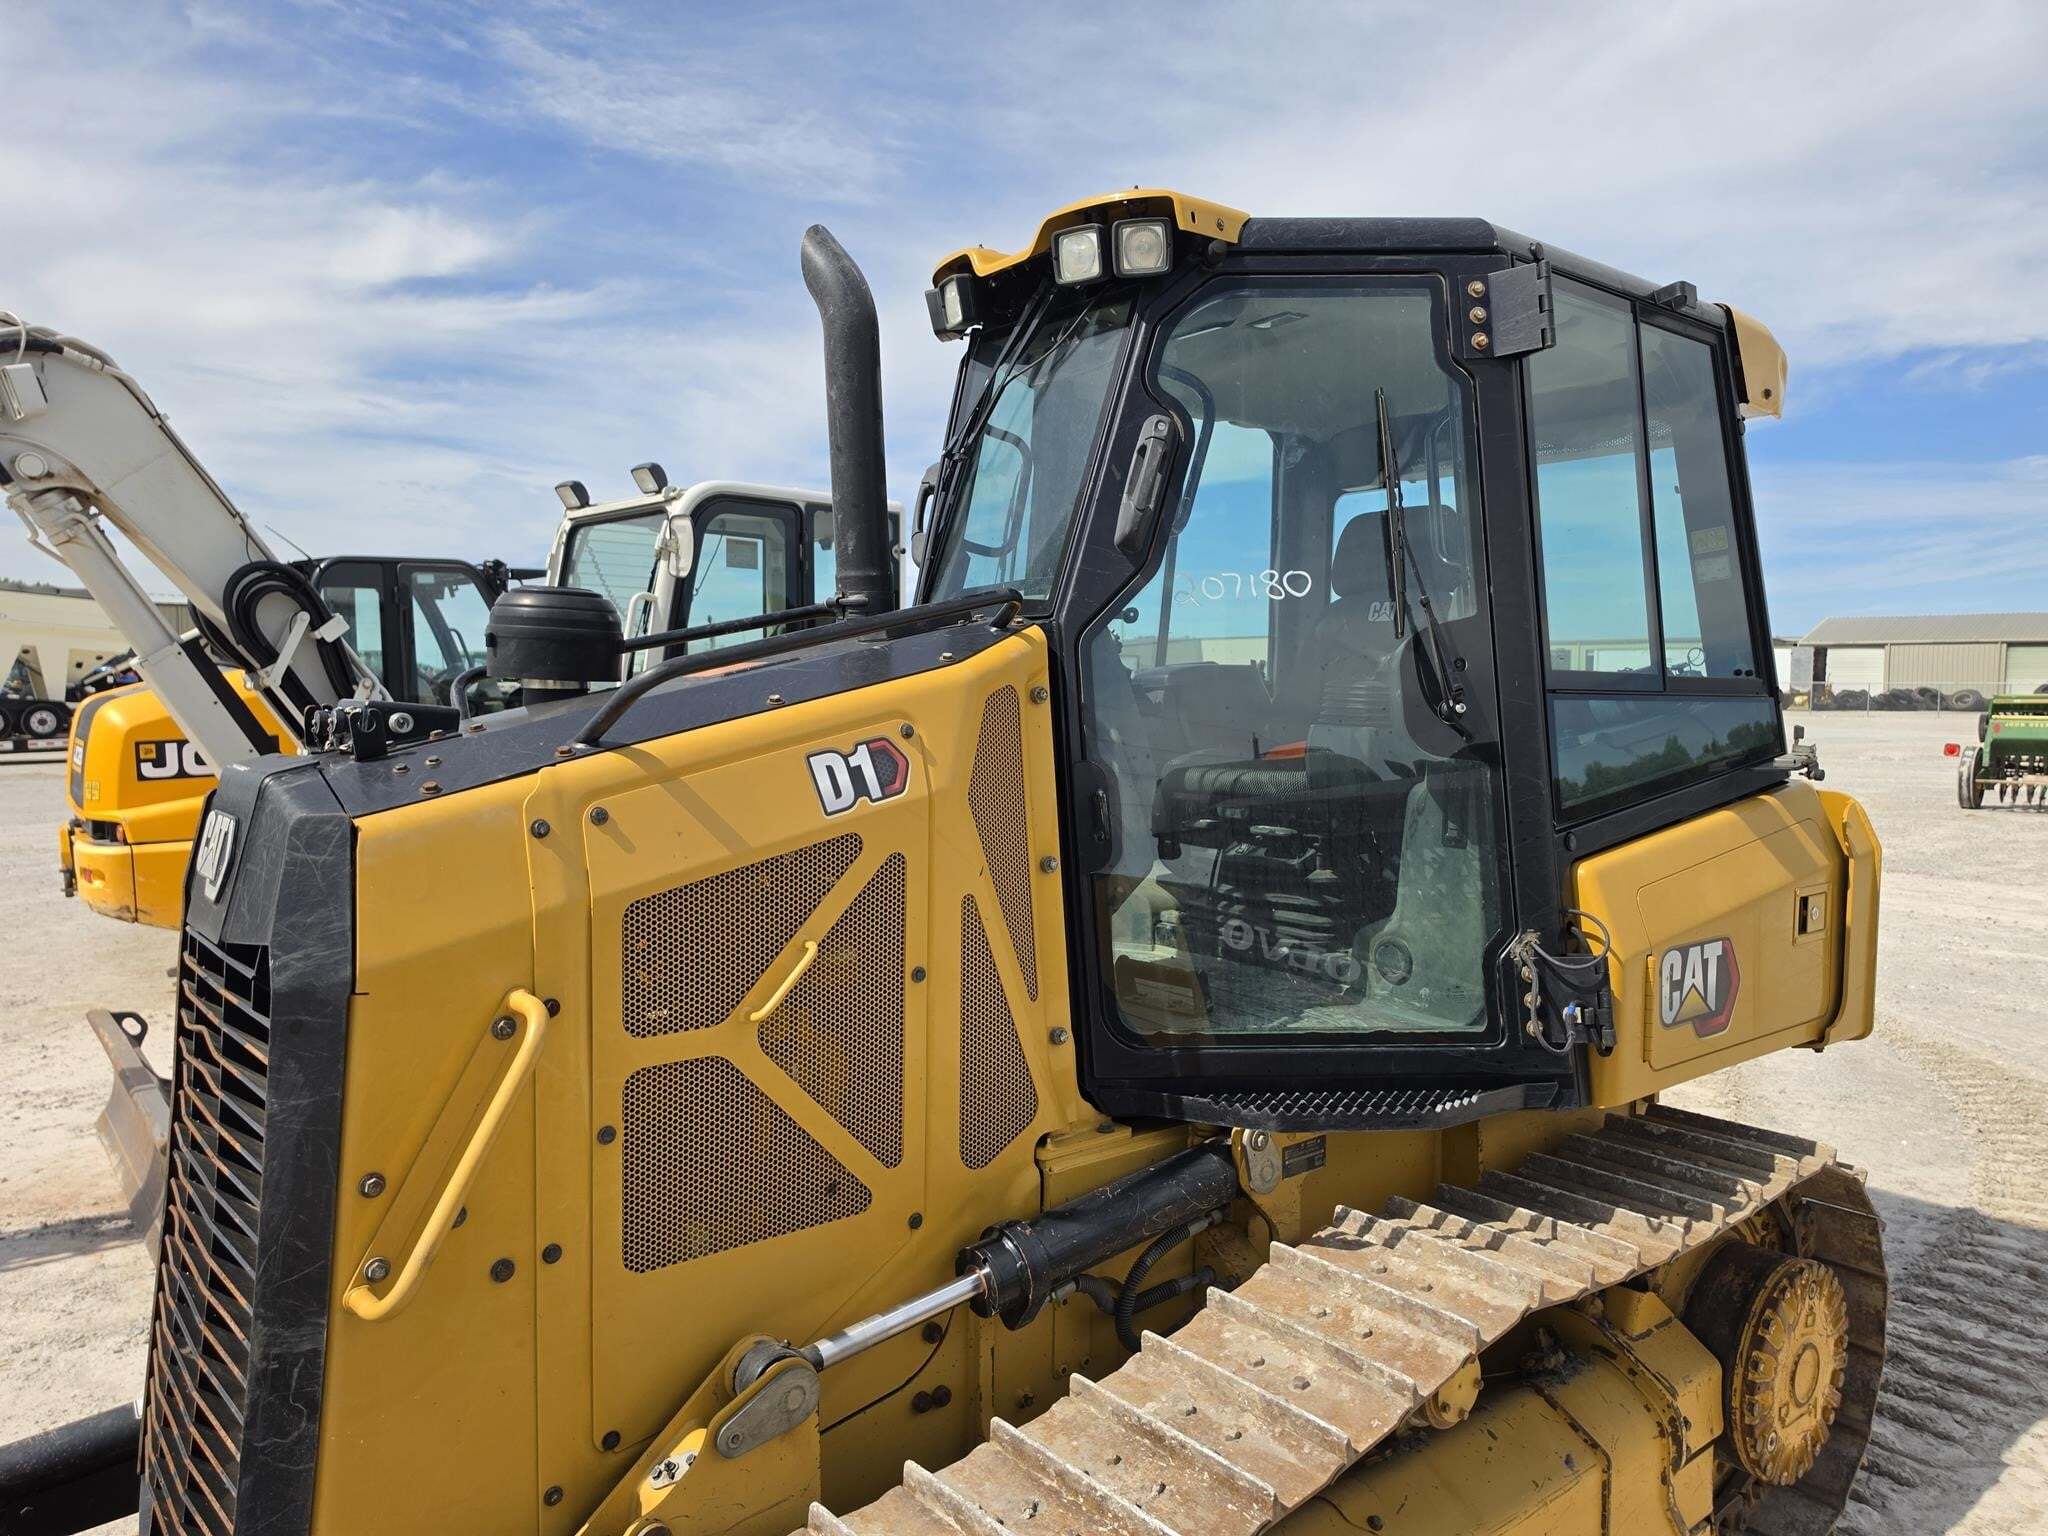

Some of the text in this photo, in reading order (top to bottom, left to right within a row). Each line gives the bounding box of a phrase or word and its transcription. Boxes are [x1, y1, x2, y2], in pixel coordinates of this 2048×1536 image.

[1173, 569, 1312, 608] 207180
[1368, 601, 1398, 622] CA
[141, 742, 215, 778] JC
[810, 743, 882, 812] D1
[197, 811, 232, 880] CAT
[1661, 940, 1723, 1024] CAT
